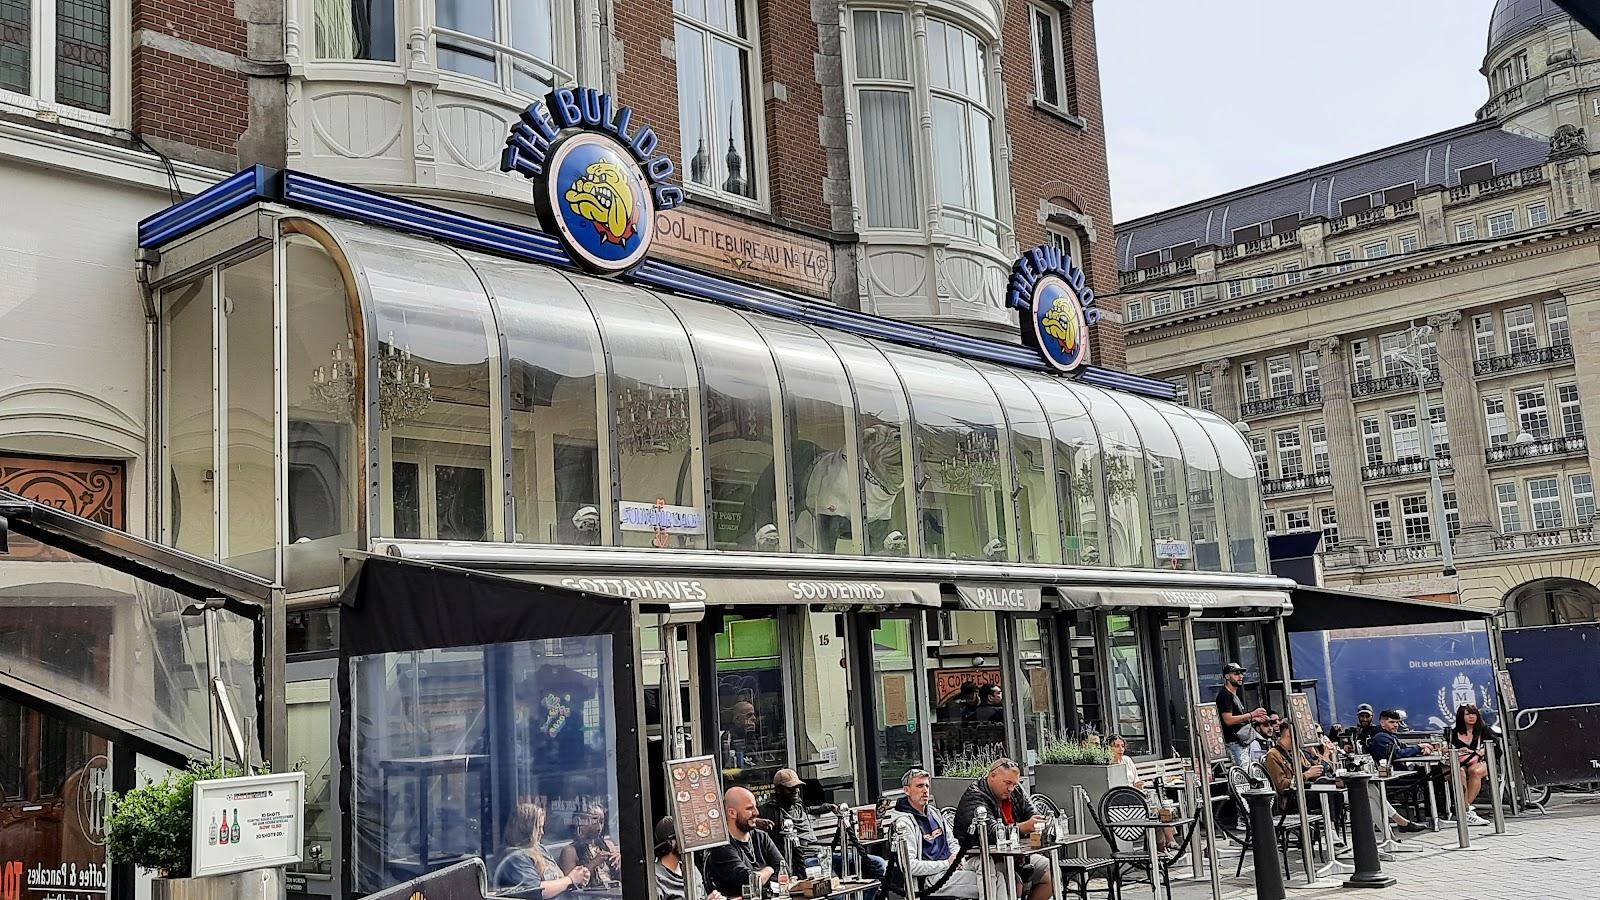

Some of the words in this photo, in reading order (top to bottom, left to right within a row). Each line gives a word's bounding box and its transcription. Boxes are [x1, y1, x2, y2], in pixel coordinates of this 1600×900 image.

[502, 100, 560, 177] THE
[548, 86, 684, 209] BULLDOG
[1008, 256, 1038, 310] THE
[1028, 244, 1100, 326] BULLDOG
[787, 582, 884, 599] SOUVENIRS
[977, 588, 1025, 607] PALACE
[819, 634, 830, 646] 15
[1409, 660, 1421, 668] Dit
[947, 672, 1000, 687] COFFEESHO
